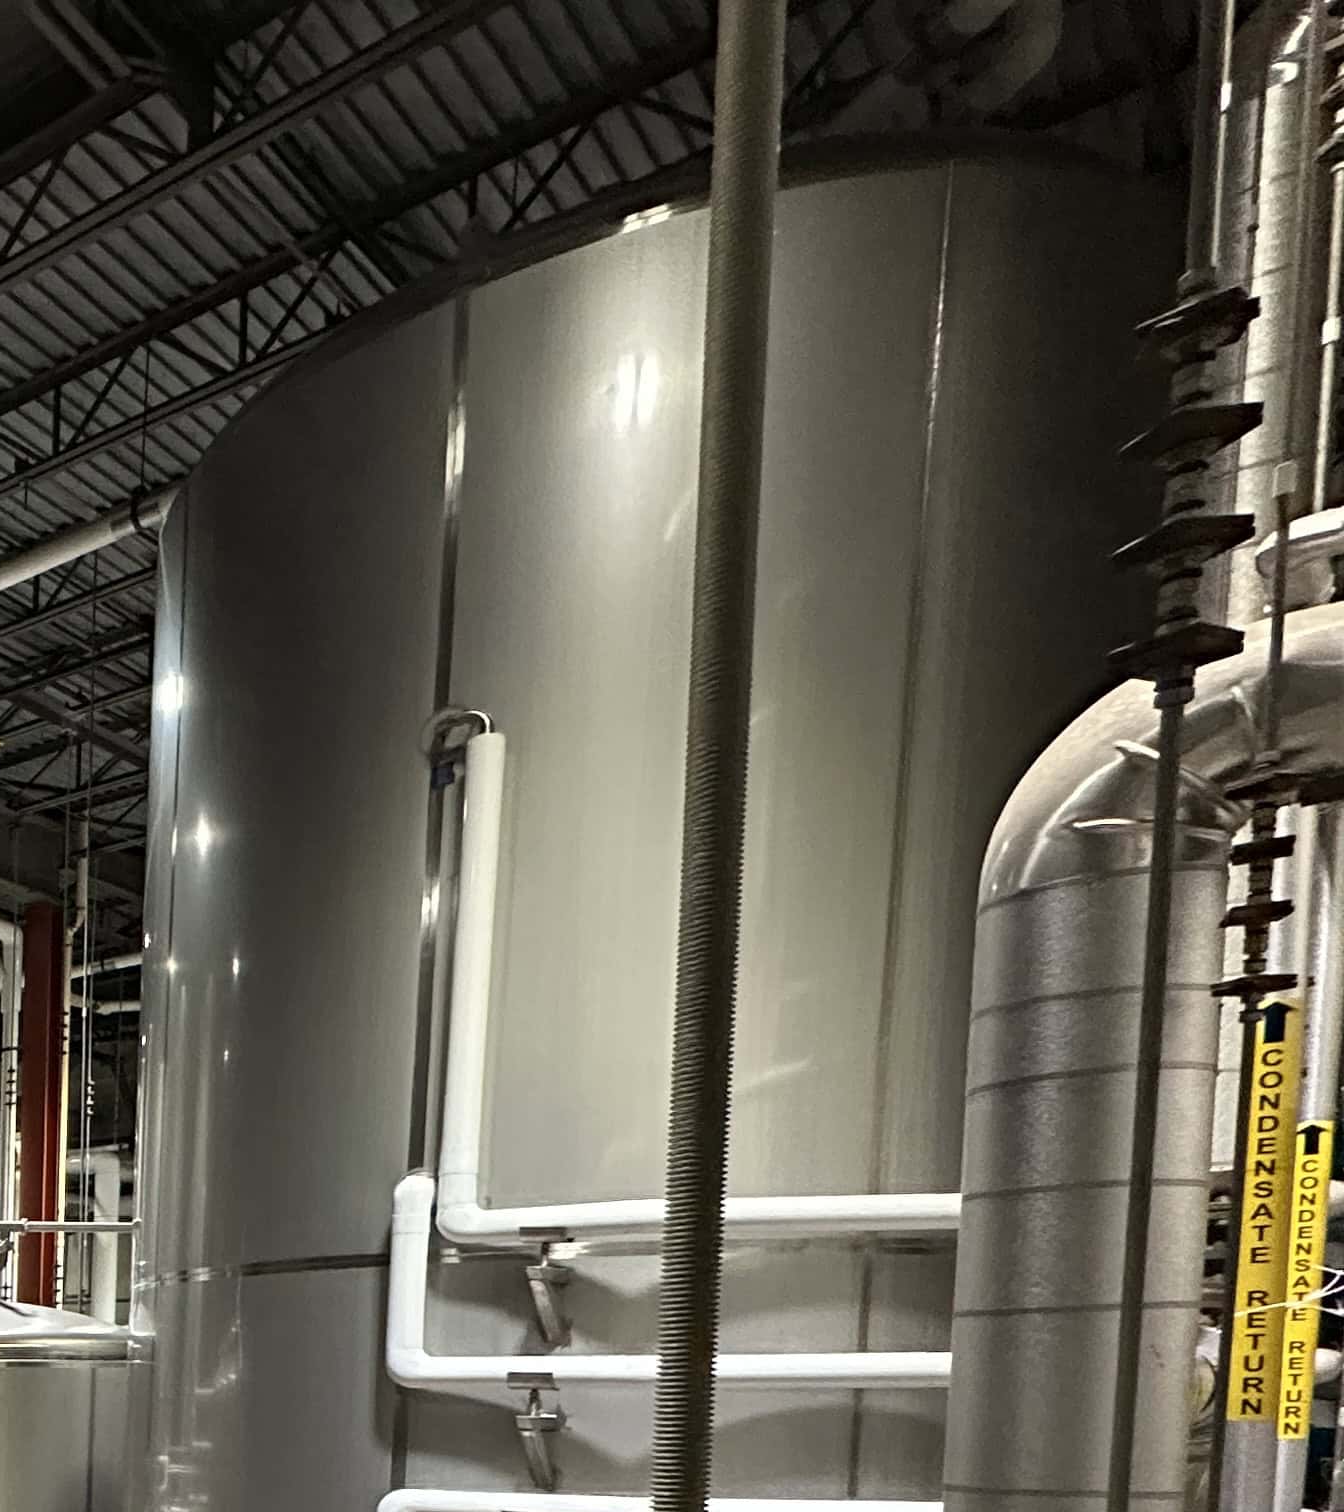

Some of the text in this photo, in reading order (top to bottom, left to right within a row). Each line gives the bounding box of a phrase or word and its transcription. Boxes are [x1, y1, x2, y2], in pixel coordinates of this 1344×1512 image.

[1241, 1049, 1284, 1415] CONDENSATE RETURN
[1284, 1161, 1318, 1434] CONDENSATE RETURN
